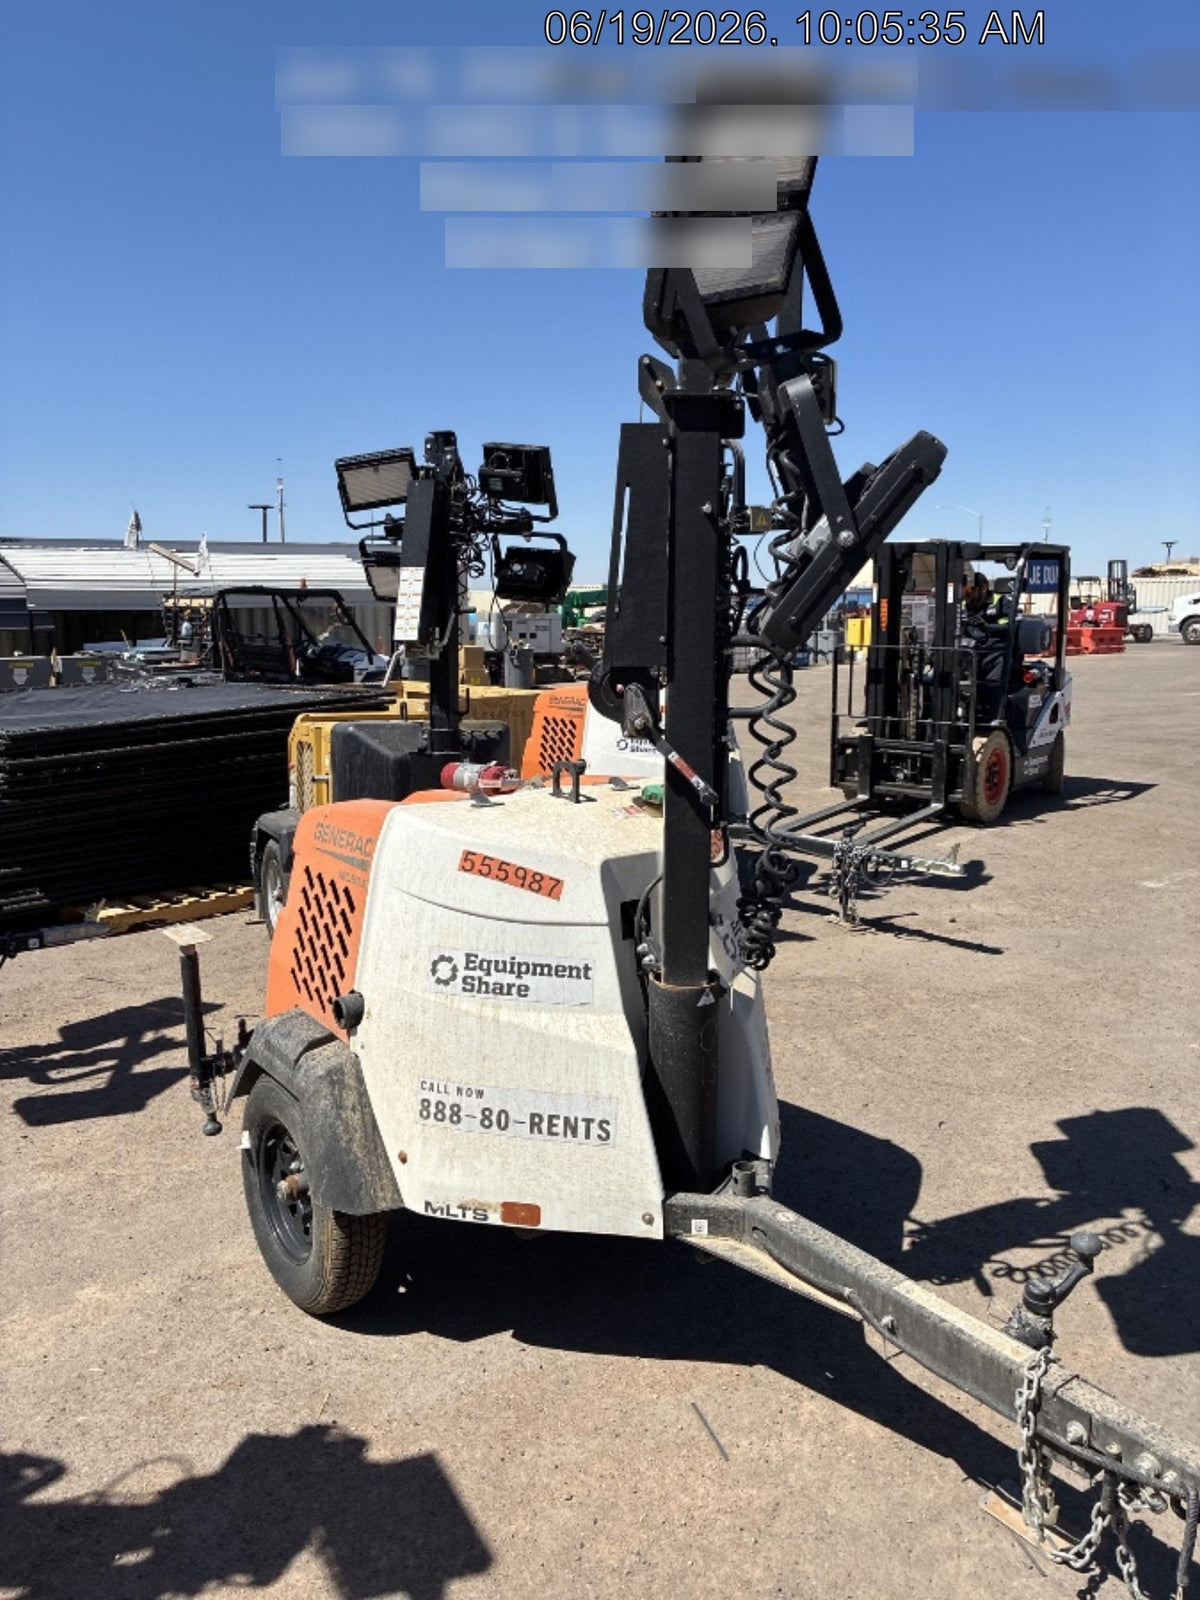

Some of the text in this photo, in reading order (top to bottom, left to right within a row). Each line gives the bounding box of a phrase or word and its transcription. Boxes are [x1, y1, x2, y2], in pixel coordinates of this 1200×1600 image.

[314, 822, 375, 857] GENERAC
[461, 851, 561, 897] 555987
[463, 952, 592, 981] Equipment
[461, 975, 530, 998] Share
[420, 1080, 485, 1100] CALL NOW
[418, 1098, 611, 1142] 888-80-RENTS
[423, 1200, 490, 1222] MLTS
